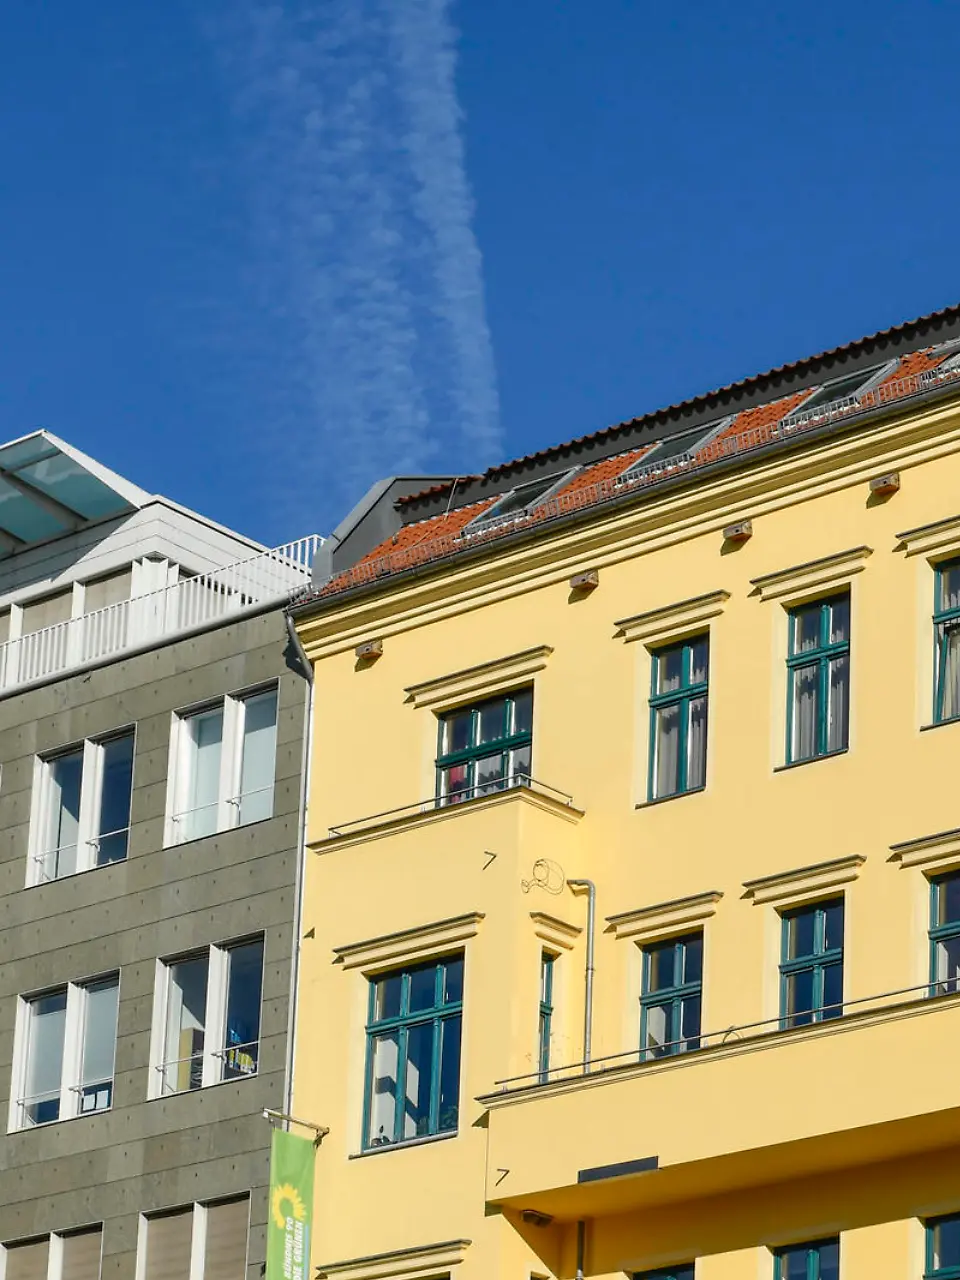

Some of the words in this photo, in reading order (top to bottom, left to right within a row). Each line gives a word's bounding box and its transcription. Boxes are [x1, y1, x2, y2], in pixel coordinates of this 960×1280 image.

[286, 1216, 293, 1230] 90
[293, 1221, 303, 1263] GRÜNEN
[284, 1232, 293, 1279] BÜNDNIS
